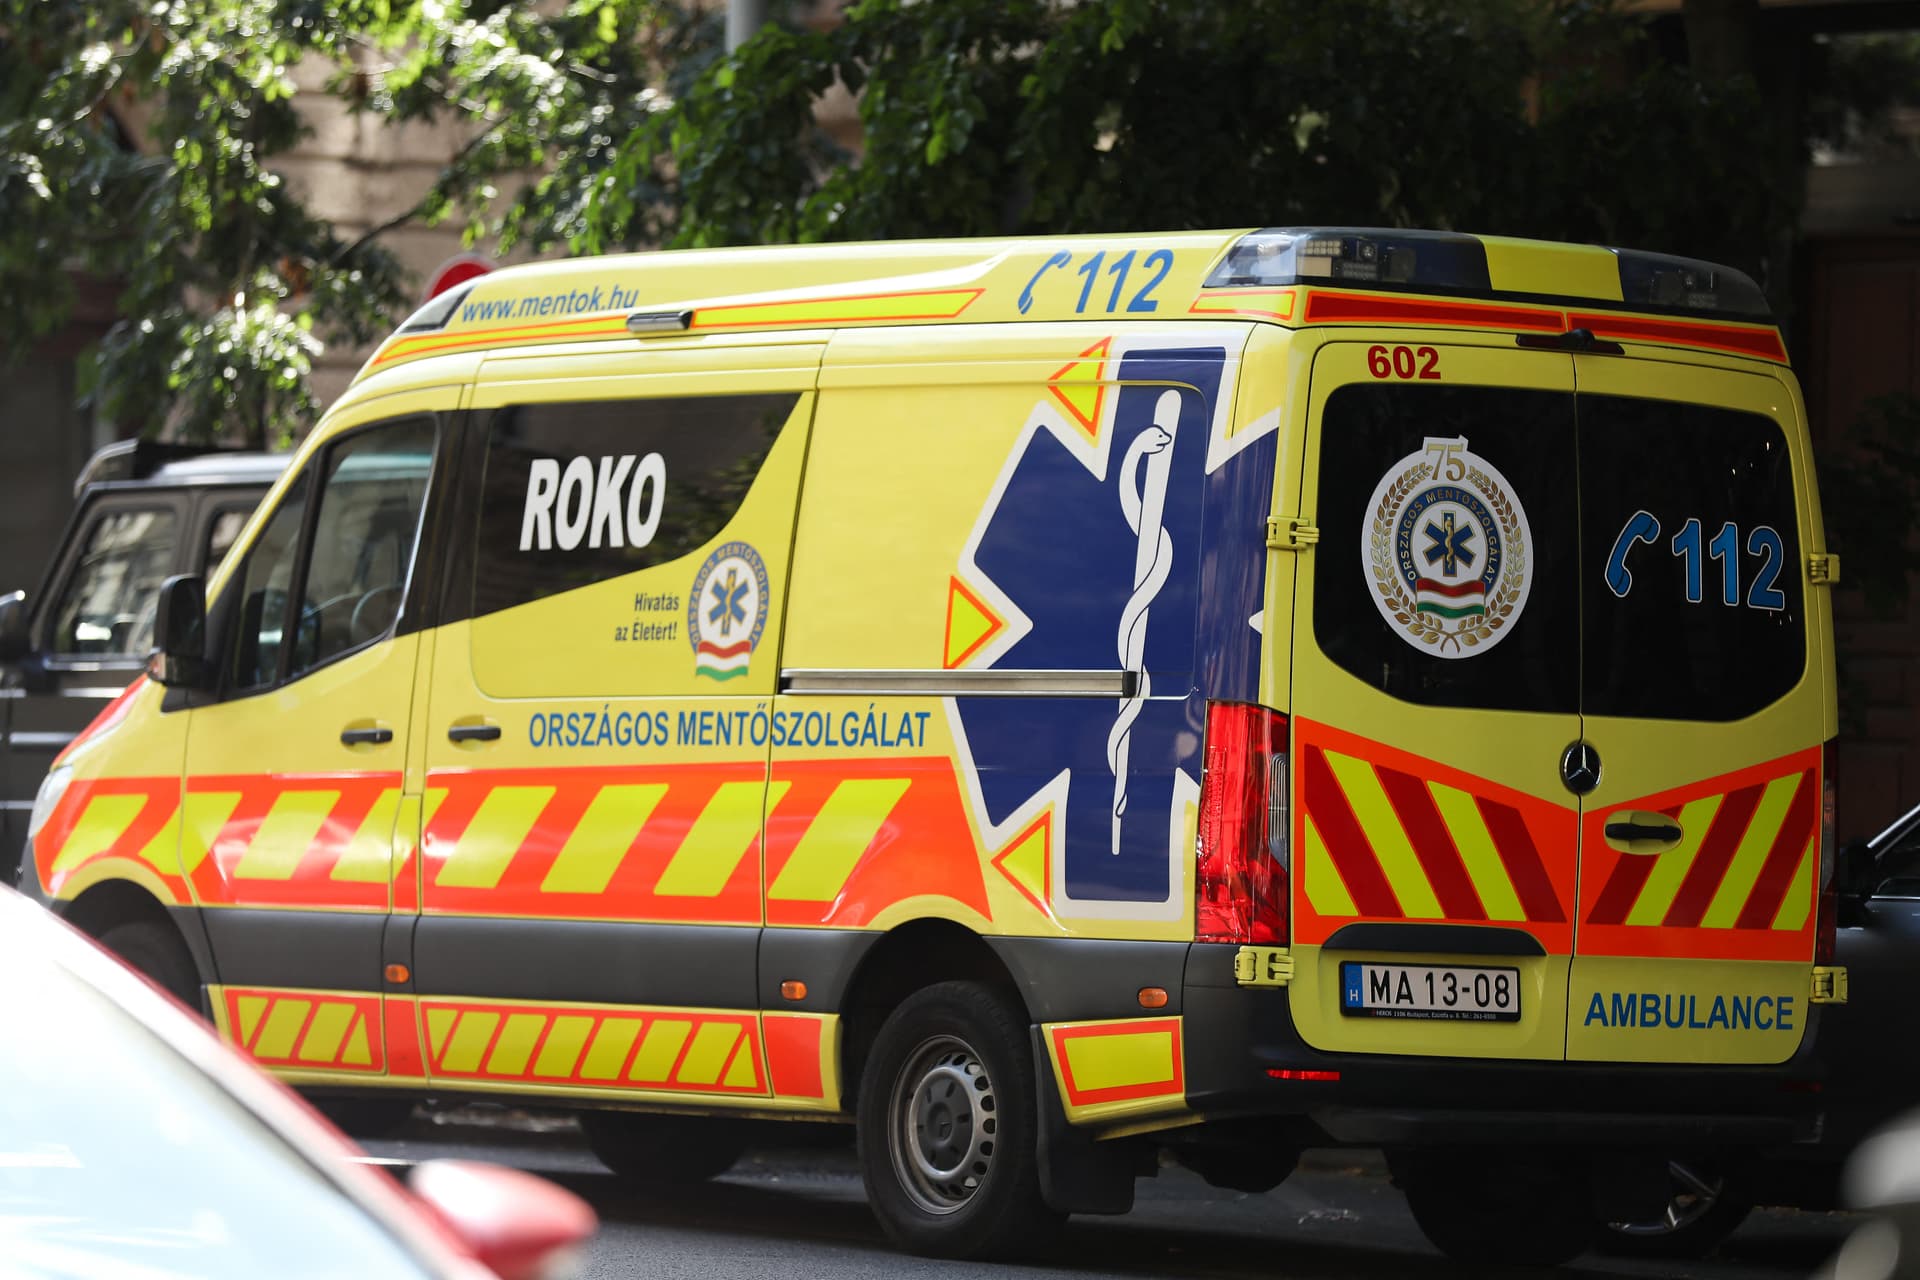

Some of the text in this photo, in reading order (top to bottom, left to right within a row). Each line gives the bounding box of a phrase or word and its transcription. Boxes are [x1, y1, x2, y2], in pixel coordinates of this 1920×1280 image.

[1075, 249, 1174, 314] 112
[462, 284, 639, 322] www.mentok.hu
[1367, 345, 1441, 380] 602
[1425, 443, 1466, 482] 75
[519, 452, 666, 551] ROKO
[1671, 517, 1785, 611] 112
[634, 592, 680, 611] Hivatás
[615, 617, 678, 641] az Életért!
[529, 702, 931, 747] ORSZÁGOS MENTŐSZOLGÁLAT
[1350, 988, 1359, 1002] H
[1370, 969, 1510, 1008] MA 13-08
[1584, 991, 1794, 1030] AMBULANCE
